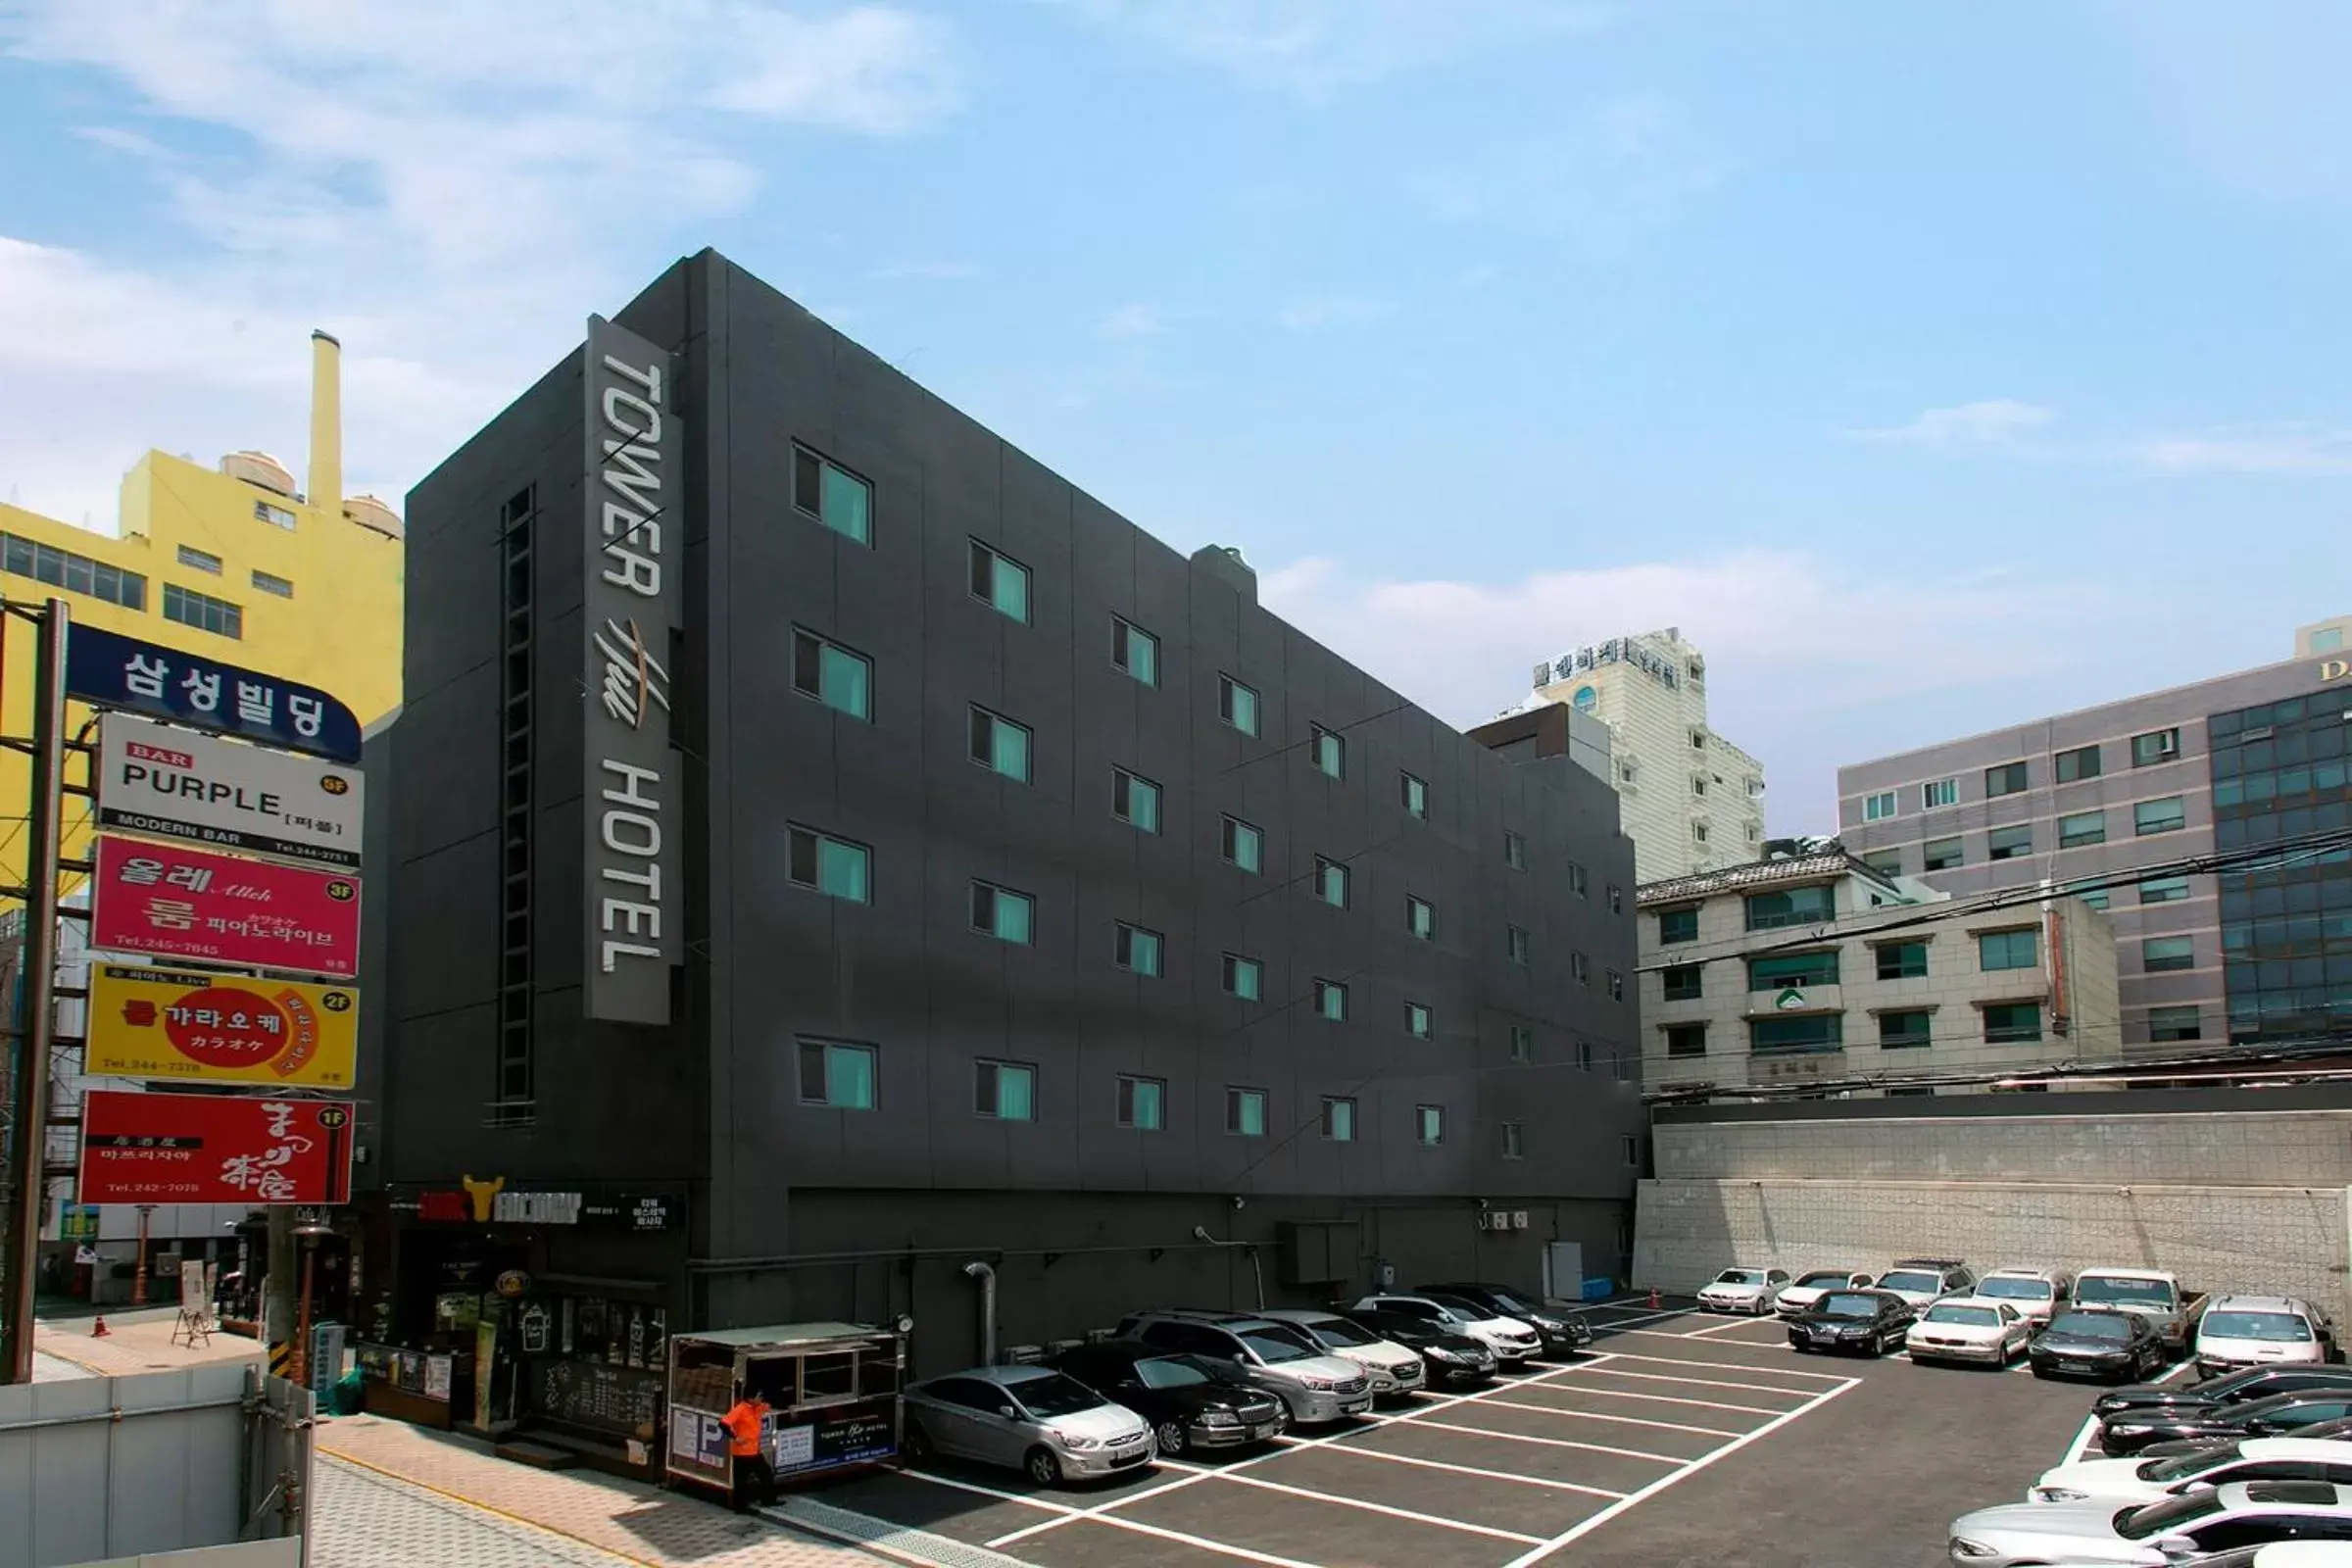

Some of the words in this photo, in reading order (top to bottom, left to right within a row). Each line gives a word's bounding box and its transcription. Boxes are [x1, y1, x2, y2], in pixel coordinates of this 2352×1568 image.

[602, 355, 663, 598] TOWER
[125, 653, 323, 737] 삼성빌딩
[131, 745, 189, 765] BAR
[122, 762, 280, 815] PURPLE
[117, 813, 198, 838] MODERN
[203, 829, 241, 844] BAR
[119, 858, 214, 893] 올레
[601, 759, 662, 974] HOTEL
[330, 884, 352, 898] 3F
[206, 916, 335, 947] 피아노라이브
[326, 995, 348, 1009] 2F
[164, 1005, 281, 1035] 가라오케
[190, 1035, 265, 1053] カラオケ
[321, 1112, 342, 1125] 1F
